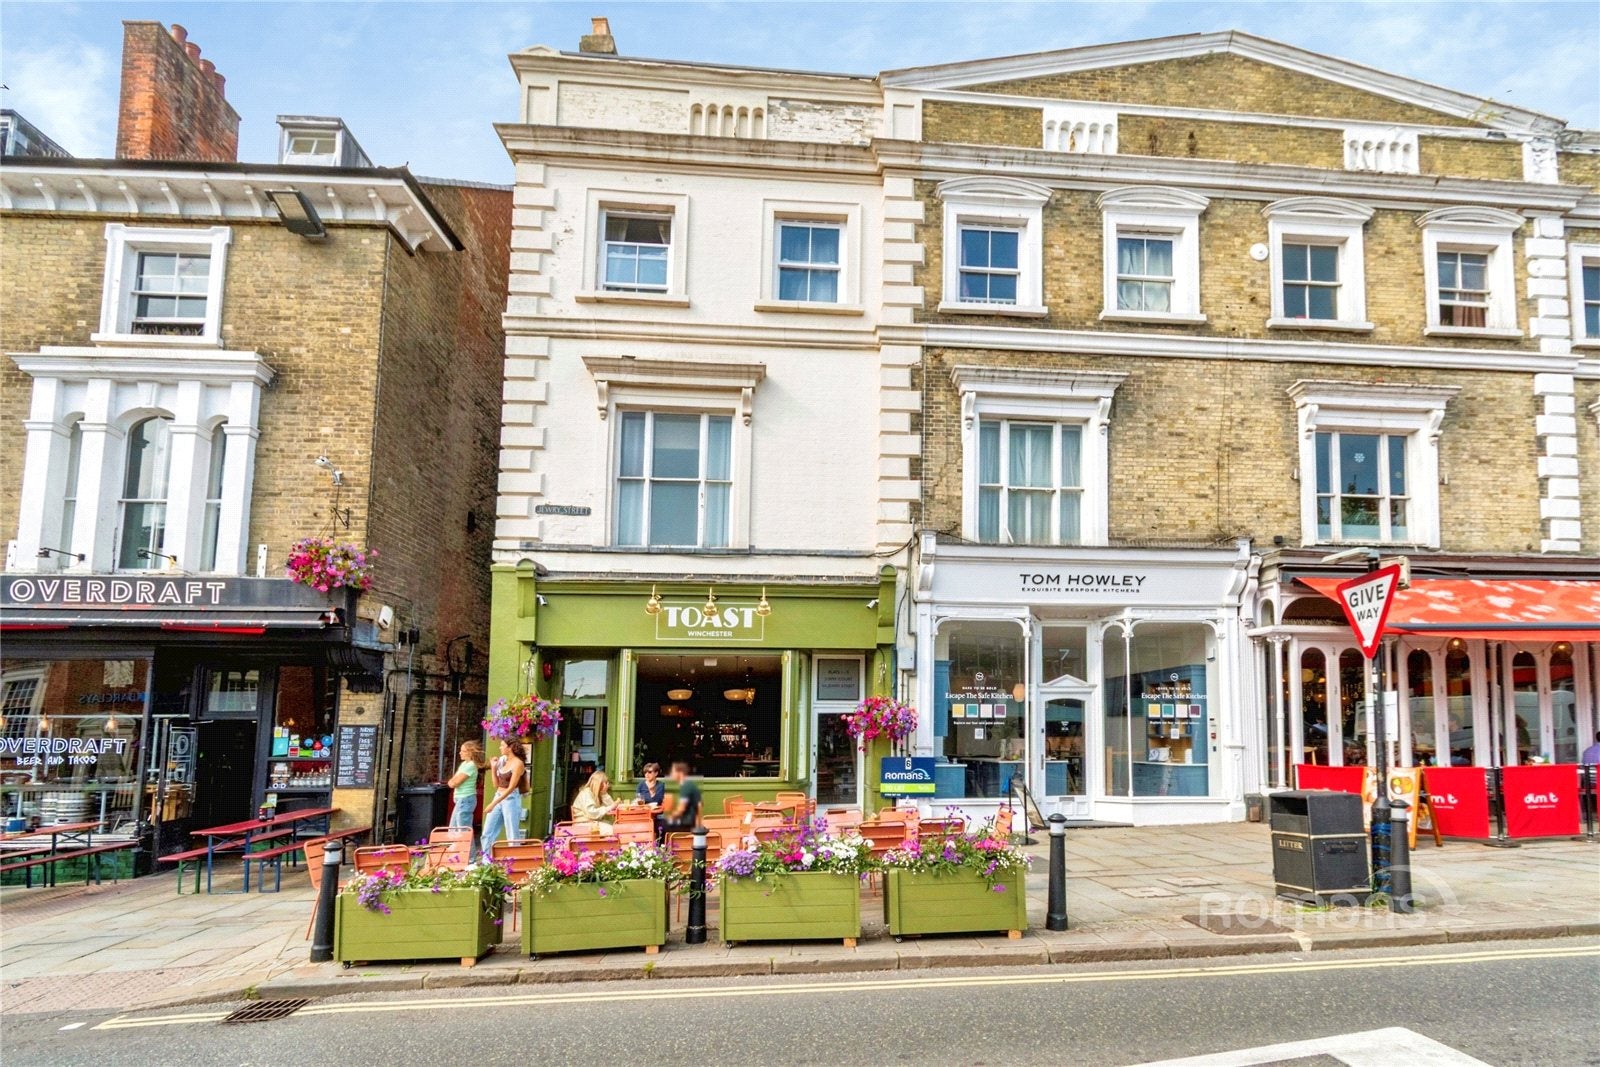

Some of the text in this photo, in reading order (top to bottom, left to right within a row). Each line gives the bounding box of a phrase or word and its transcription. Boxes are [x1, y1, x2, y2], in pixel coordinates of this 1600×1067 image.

[537, 505, 588, 515] JEWRY STREET
[1019, 573, 1147, 586] TOM HOWLEY
[9, 578, 226, 605] OVERDRAFT
[1349, 583, 1385, 608] GIVE
[663, 606, 758, 629] TOAST
[1356, 606, 1379, 621] WAY
[687, 630, 733, 638] WINCHESTER
[1058, 648, 1071, 661] 7
[945, 692, 966, 700] Escape
[1141, 692, 1161, 700] Escape
[16, 755, 98, 766] BEER AND TACOS
[1279, 839, 1303, 850] LITTER
